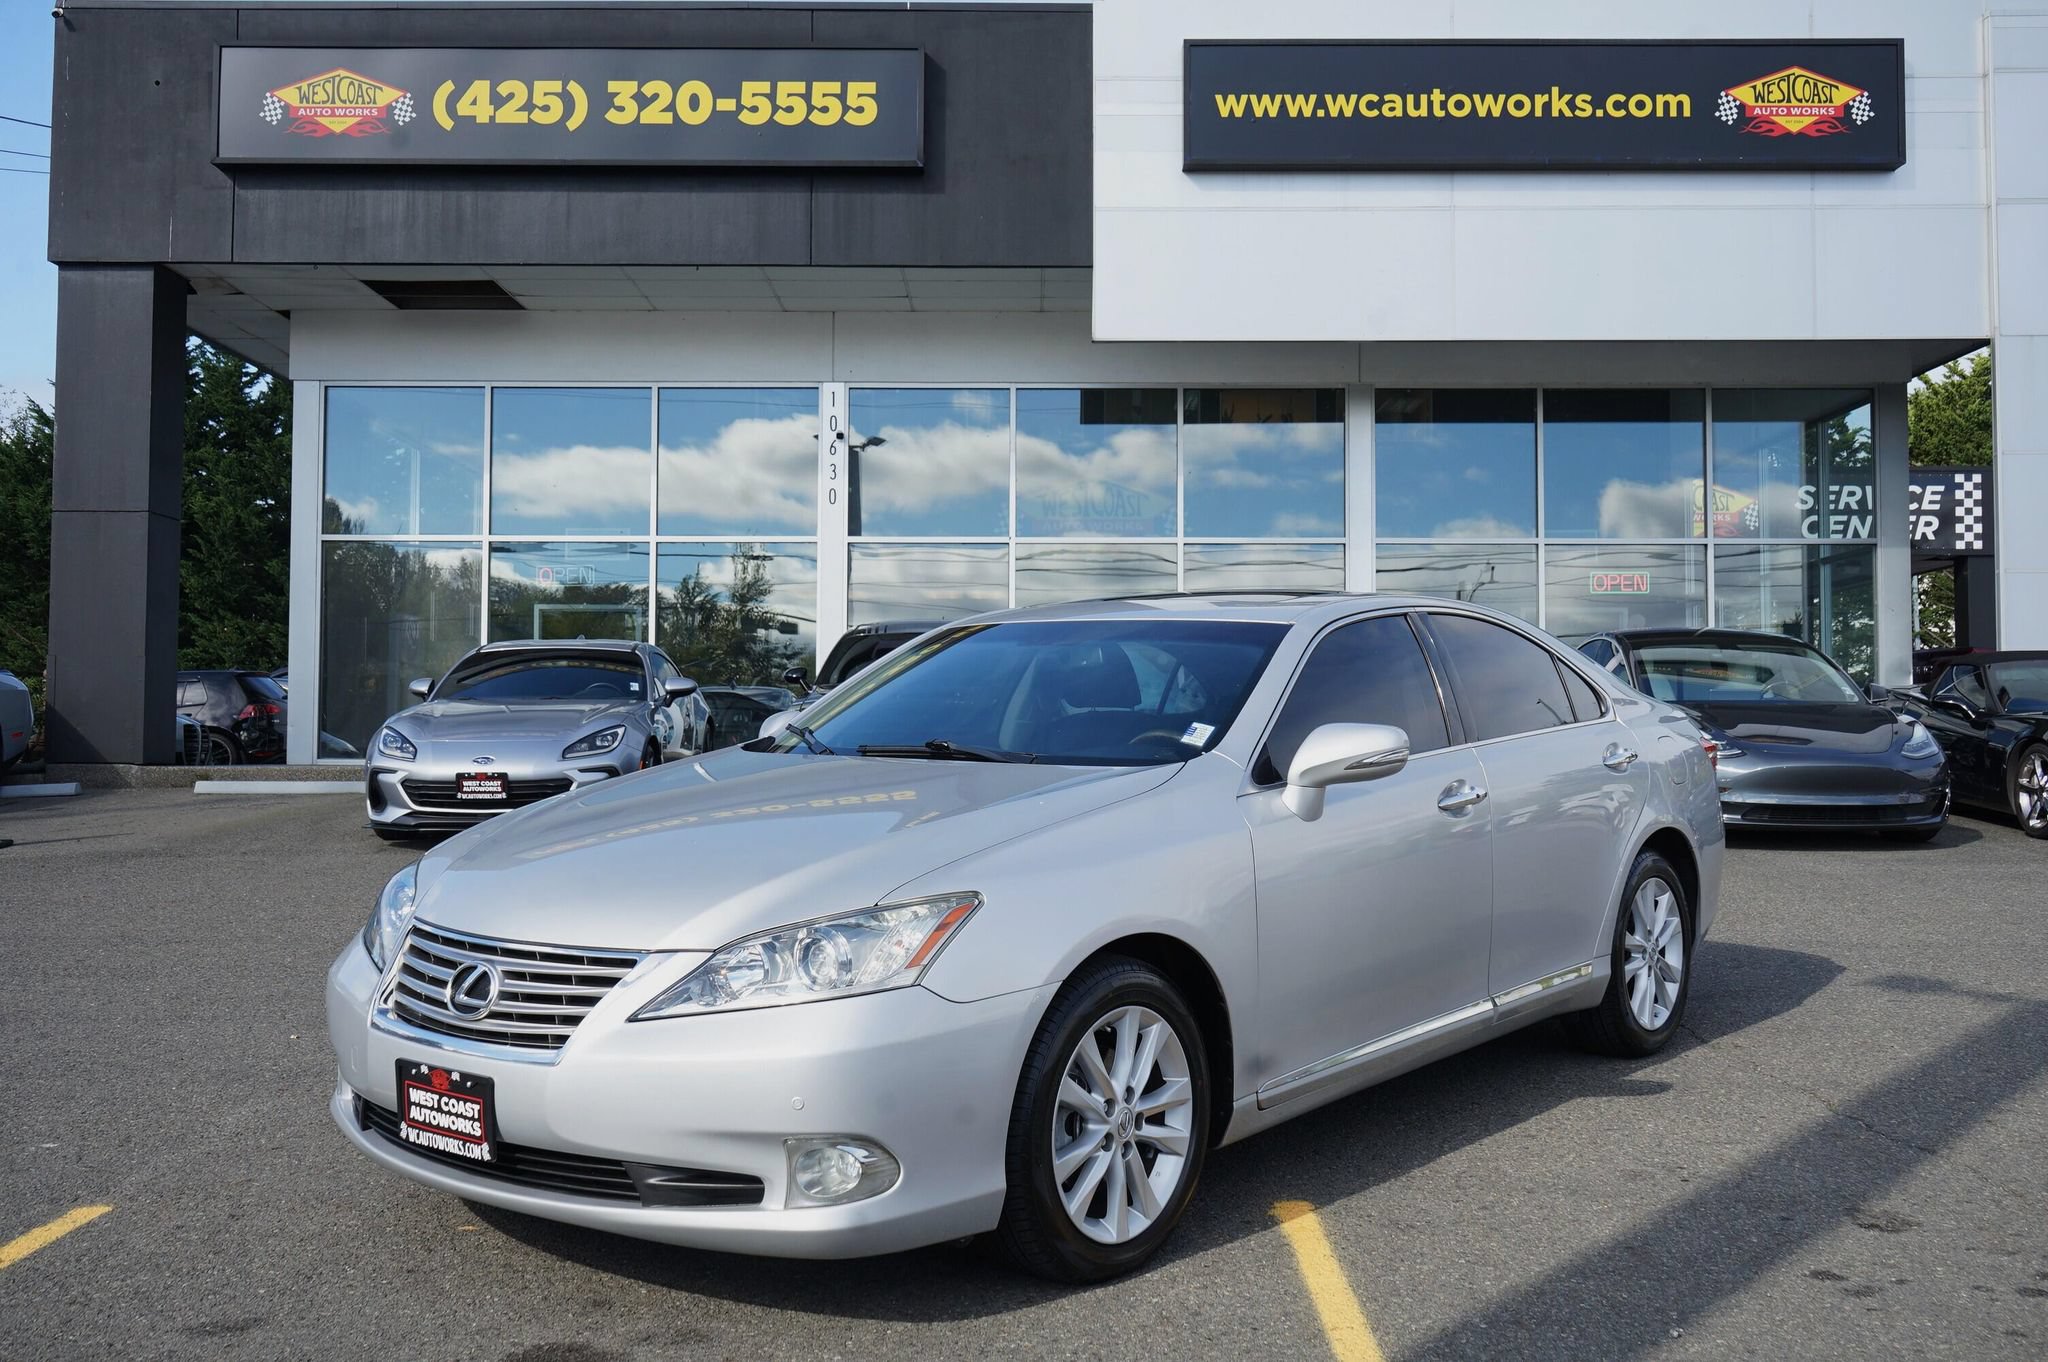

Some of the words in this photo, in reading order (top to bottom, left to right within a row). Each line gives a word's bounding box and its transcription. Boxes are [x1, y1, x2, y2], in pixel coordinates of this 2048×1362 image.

[298, 107, 332, 116] AUTO
[335, 107, 378, 116] WORKS
[432, 78, 589, 132] (425)
[604, 79, 879, 127] 320-5555
[1214, 86, 1692, 119] www.wcautoworks.com
[1753, 107, 1788, 115] AUTO
[1791, 107, 1836, 115] WORKS
[1801, 514, 1940, 540] CENR
[539, 567, 592, 584] OPEN
[1593, 574, 1647, 591] OPEN
[409, 1087, 440, 1108] WEST
[440, 1096, 480, 1119] COAST
[409, 1105, 482, 1137] AUTOWORKS
